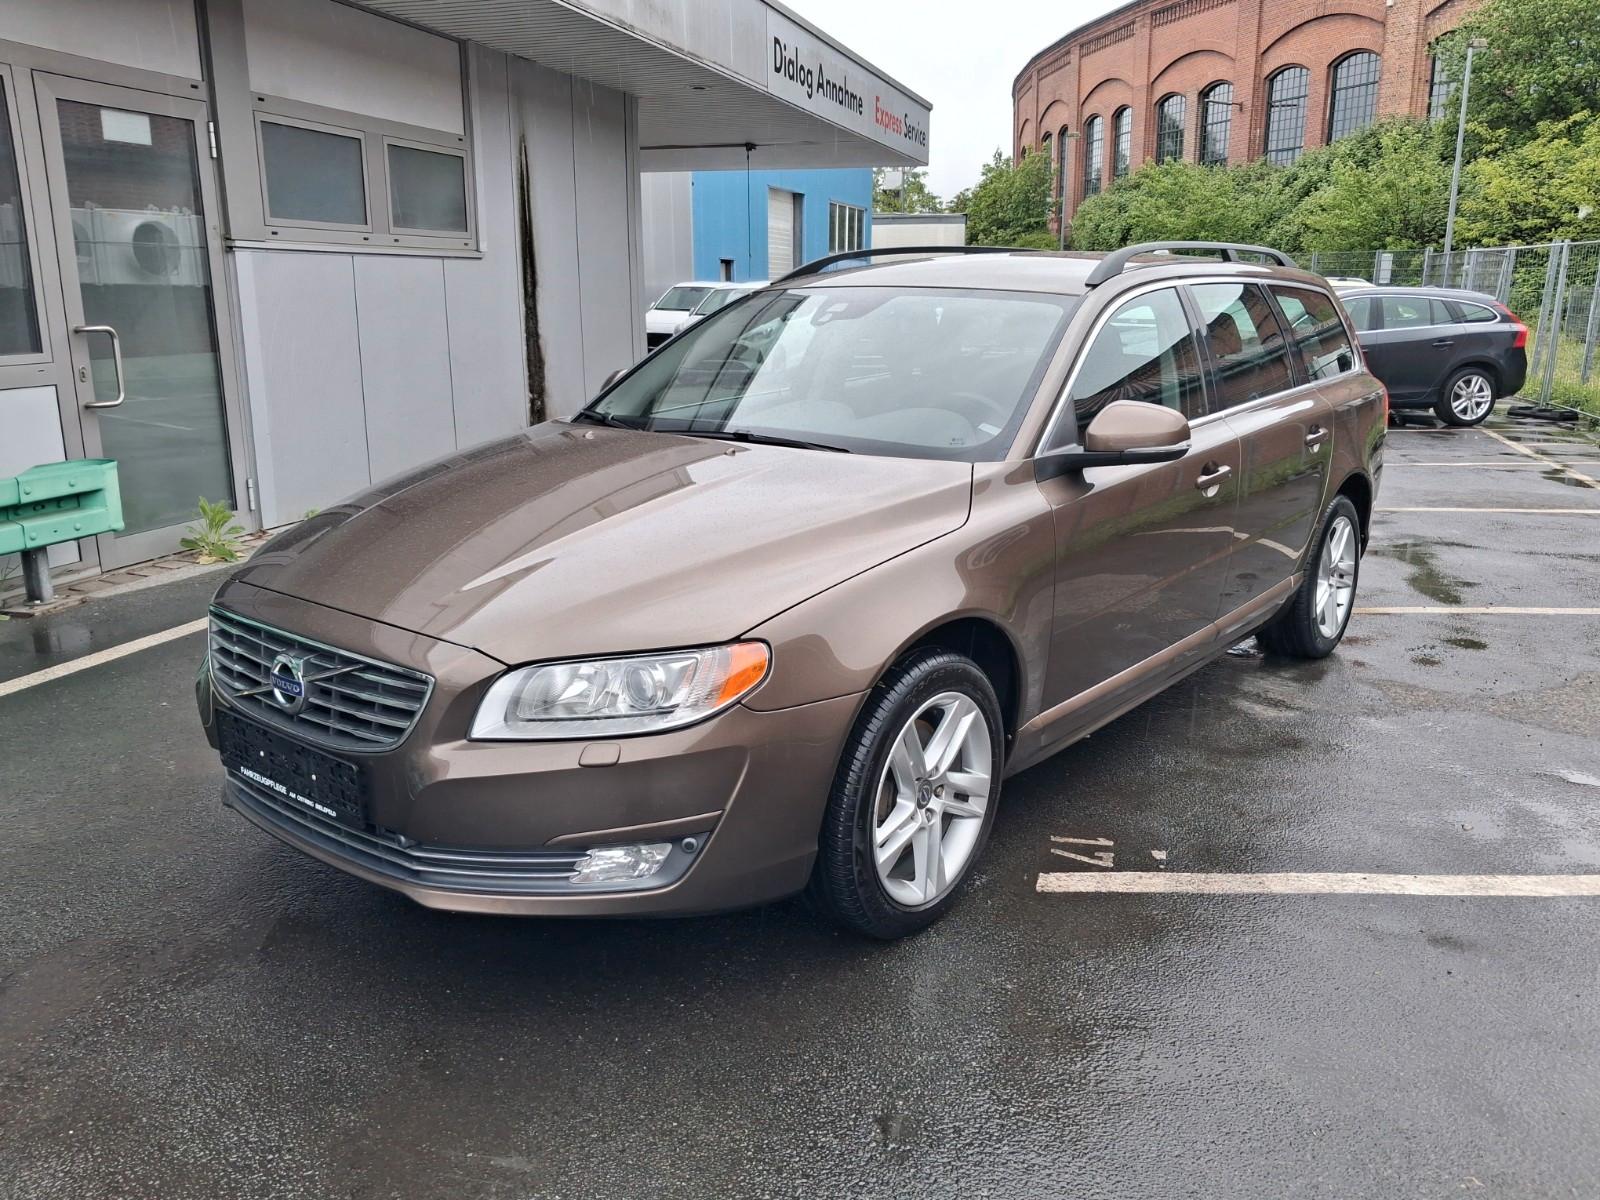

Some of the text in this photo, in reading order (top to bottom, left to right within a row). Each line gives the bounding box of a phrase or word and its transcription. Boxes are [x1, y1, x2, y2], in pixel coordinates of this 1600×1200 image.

[773, 36, 864, 116] Dialog Annahme
[875, 95, 927, 147] Express Service
[271, 676, 300, 693] VOLVO
